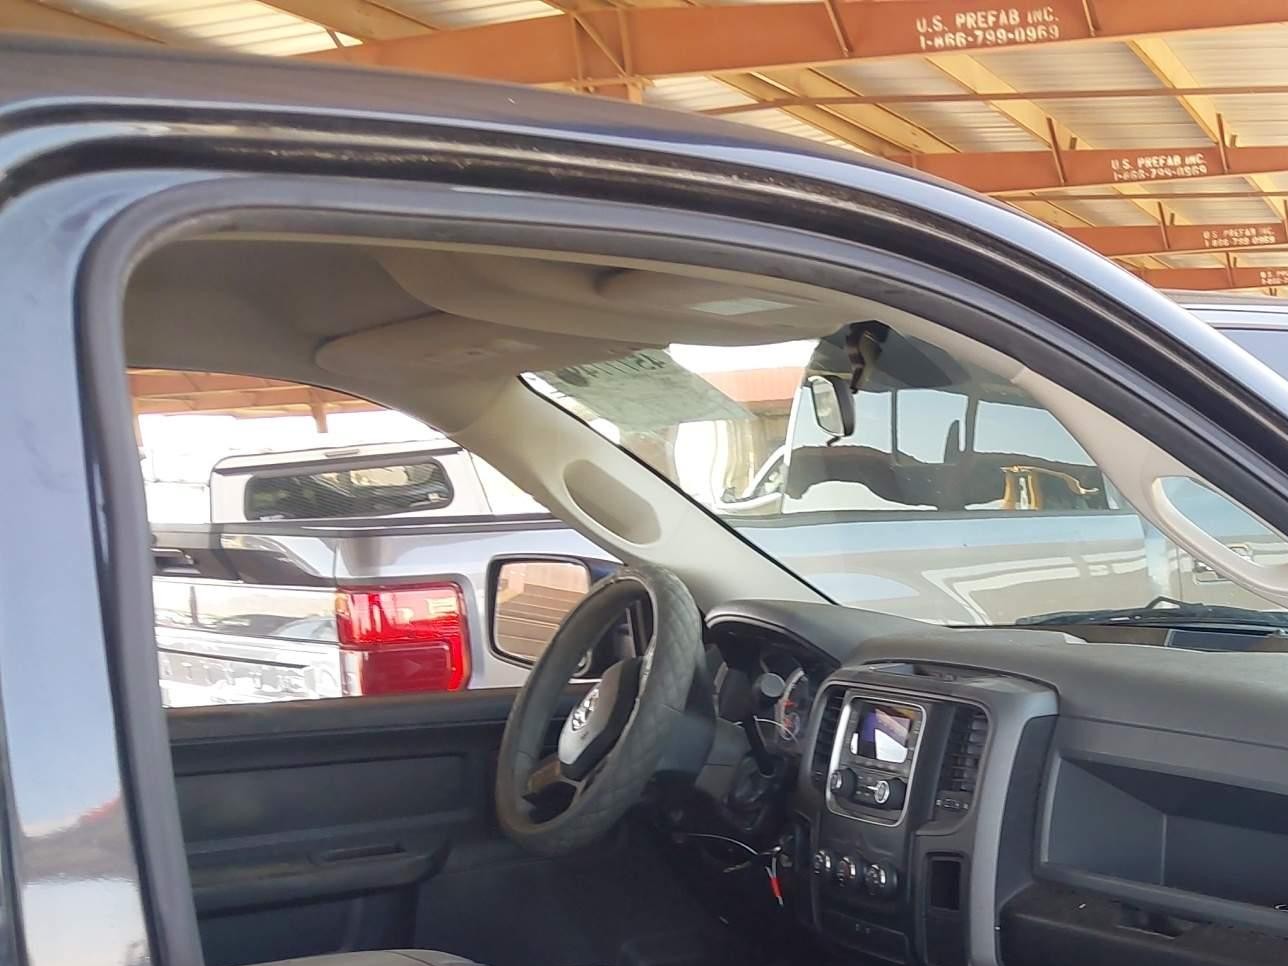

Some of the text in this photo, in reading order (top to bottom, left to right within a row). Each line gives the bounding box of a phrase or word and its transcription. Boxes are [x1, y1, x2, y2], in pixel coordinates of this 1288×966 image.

[916, 6, 1060, 33] U.S. PREFAB INC.
[1136, 154, 1182, 168] PREFAB
